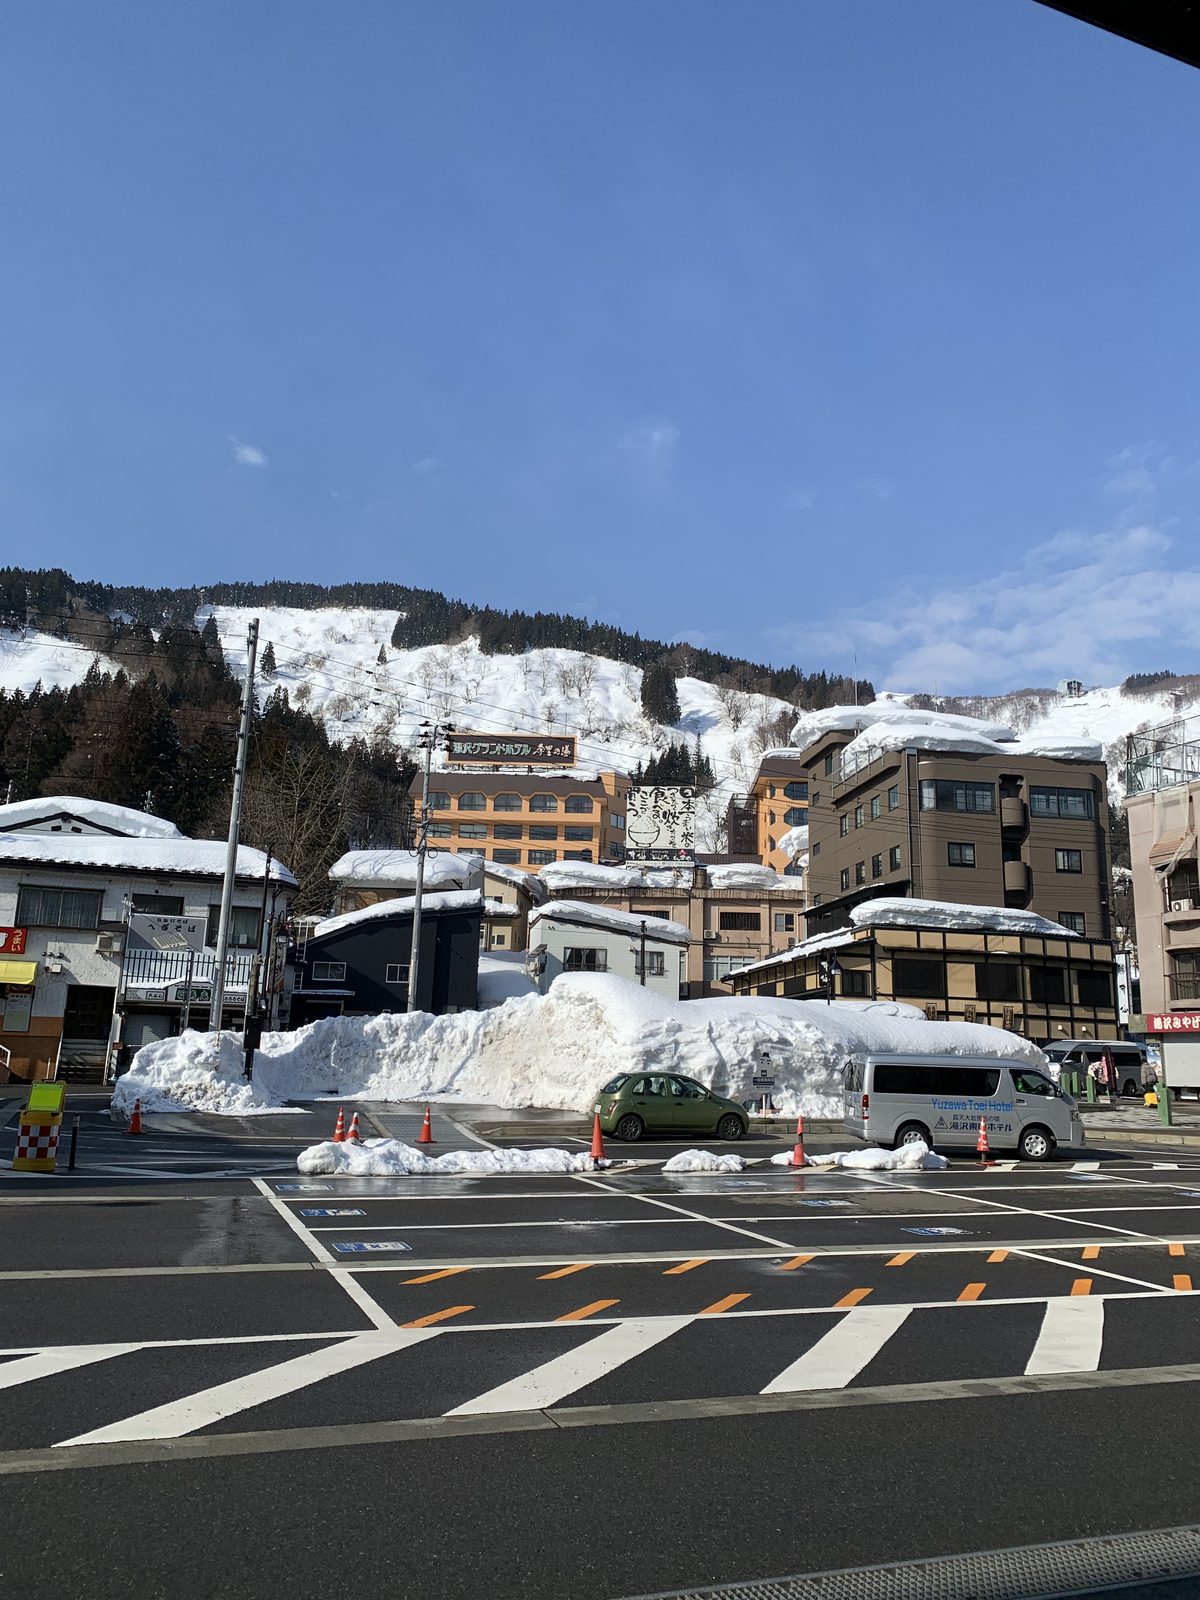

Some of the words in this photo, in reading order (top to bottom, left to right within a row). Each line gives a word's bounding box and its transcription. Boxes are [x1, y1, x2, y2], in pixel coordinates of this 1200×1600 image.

[453, 742, 532, 755] 湯沢グランドホテル
[147, 923, 196, 932] へぎそば
[12, 929, 23, 951] うまい
[931, 1098, 966, 1110] Yuzawa
[968, 1100, 987, 1111] Toei
[989, 1101, 1013, 1112] Hotel
[949, 1122, 1013, 1132] 湯沢東ホテル
